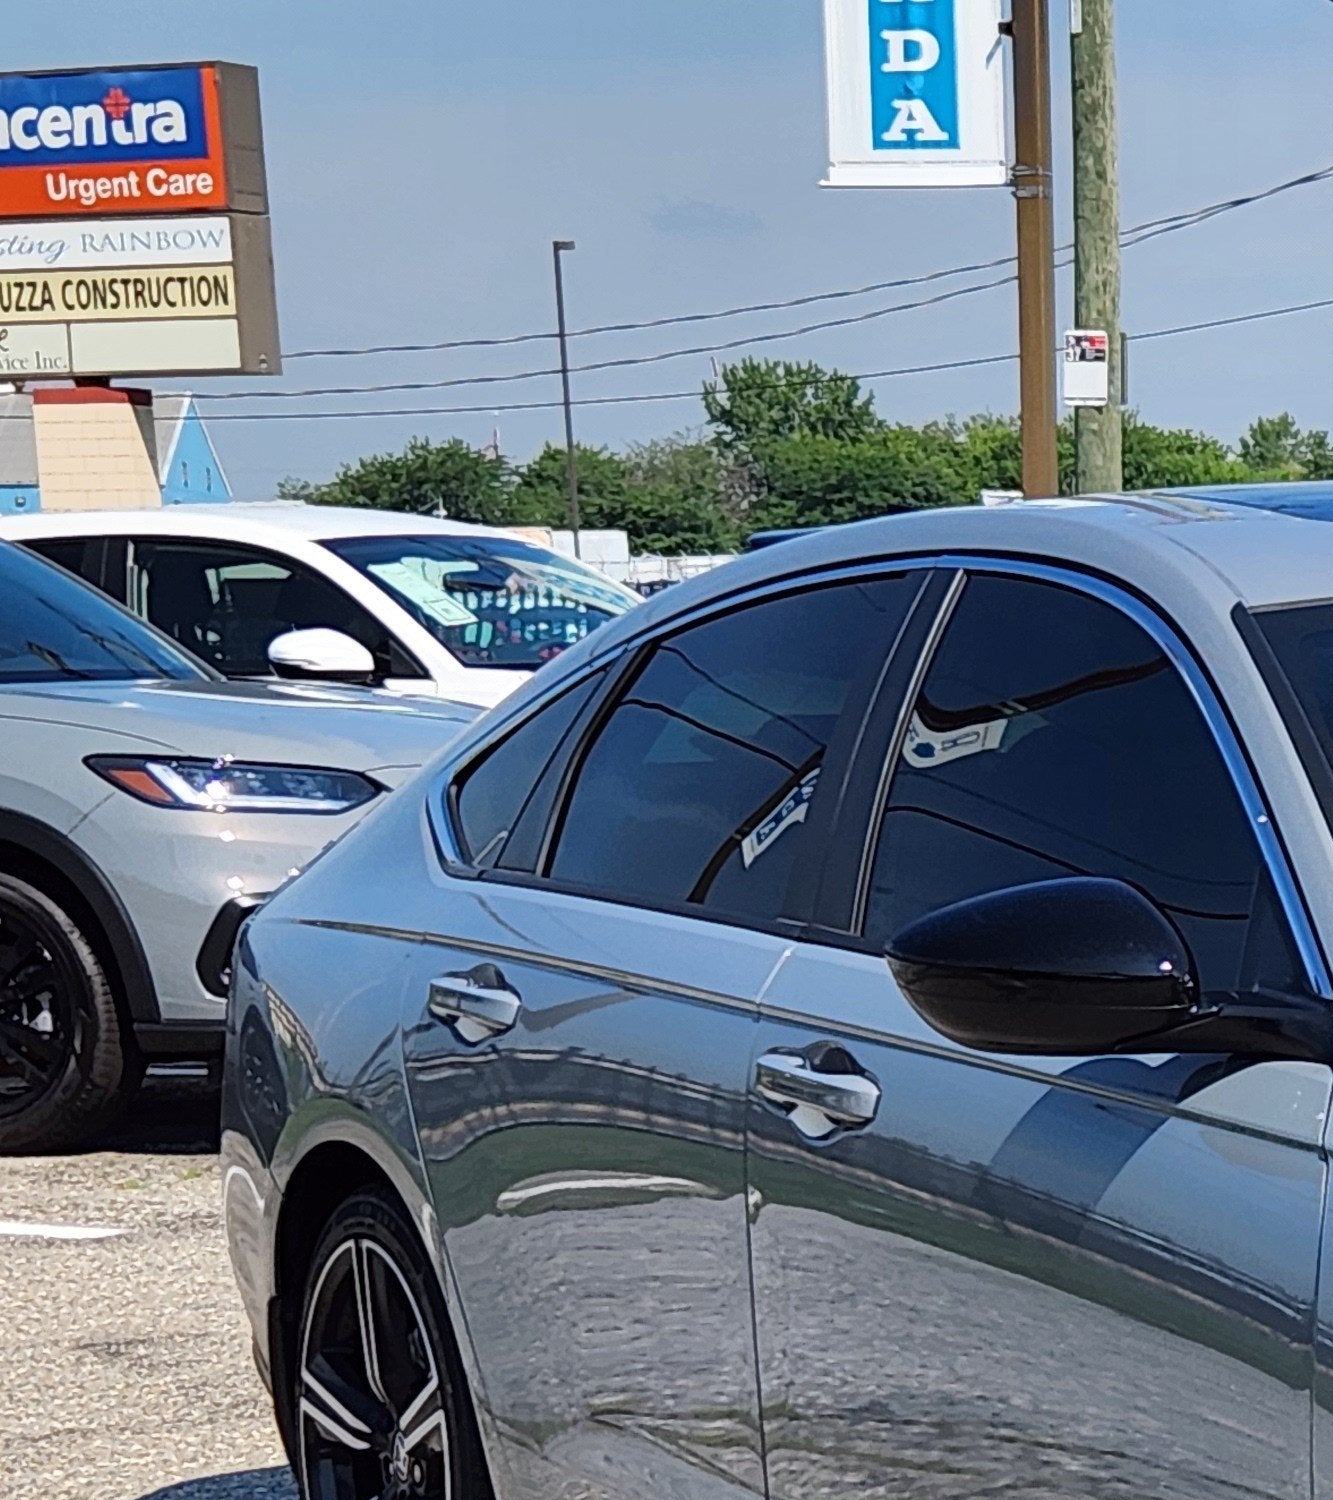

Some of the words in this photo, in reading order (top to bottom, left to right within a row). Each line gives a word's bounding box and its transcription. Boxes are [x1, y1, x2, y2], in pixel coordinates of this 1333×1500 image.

[880, 0, 950, 141] DA
[45, 170, 141, 206] Urgent
[146, 168, 213, 197] Care
[81, 229, 225, 253] RAINBOW
[61, 273, 230, 311] CONSTRUCTION
[35, 350, 67, 370] Inc.
